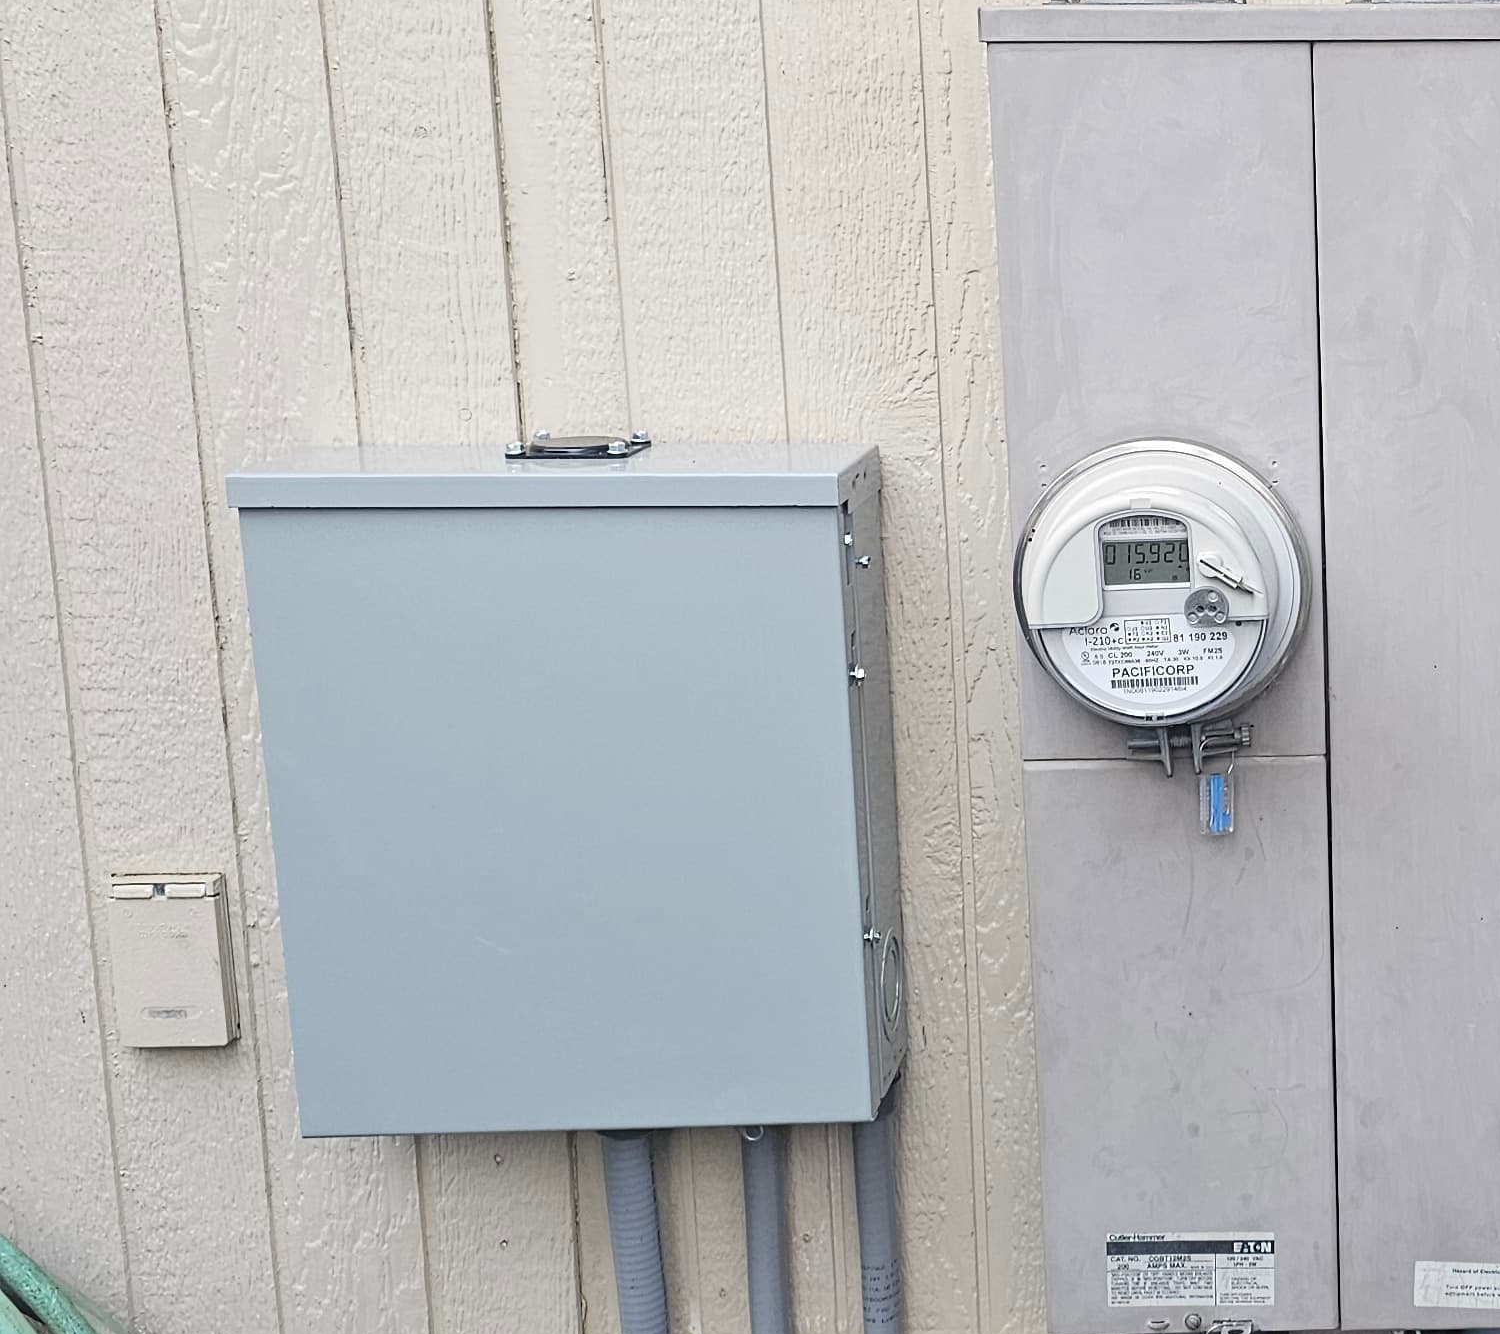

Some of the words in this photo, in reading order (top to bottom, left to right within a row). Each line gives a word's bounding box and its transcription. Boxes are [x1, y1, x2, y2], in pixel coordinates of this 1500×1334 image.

[1173, 634, 1184, 642] 81
[1189, 633, 1206, 641] 190
[1209, 632, 1228, 641] 229
[1112, 664, 1194, 678] PACIFICORP
[1233, 1242, 1272, 1253] EATON
